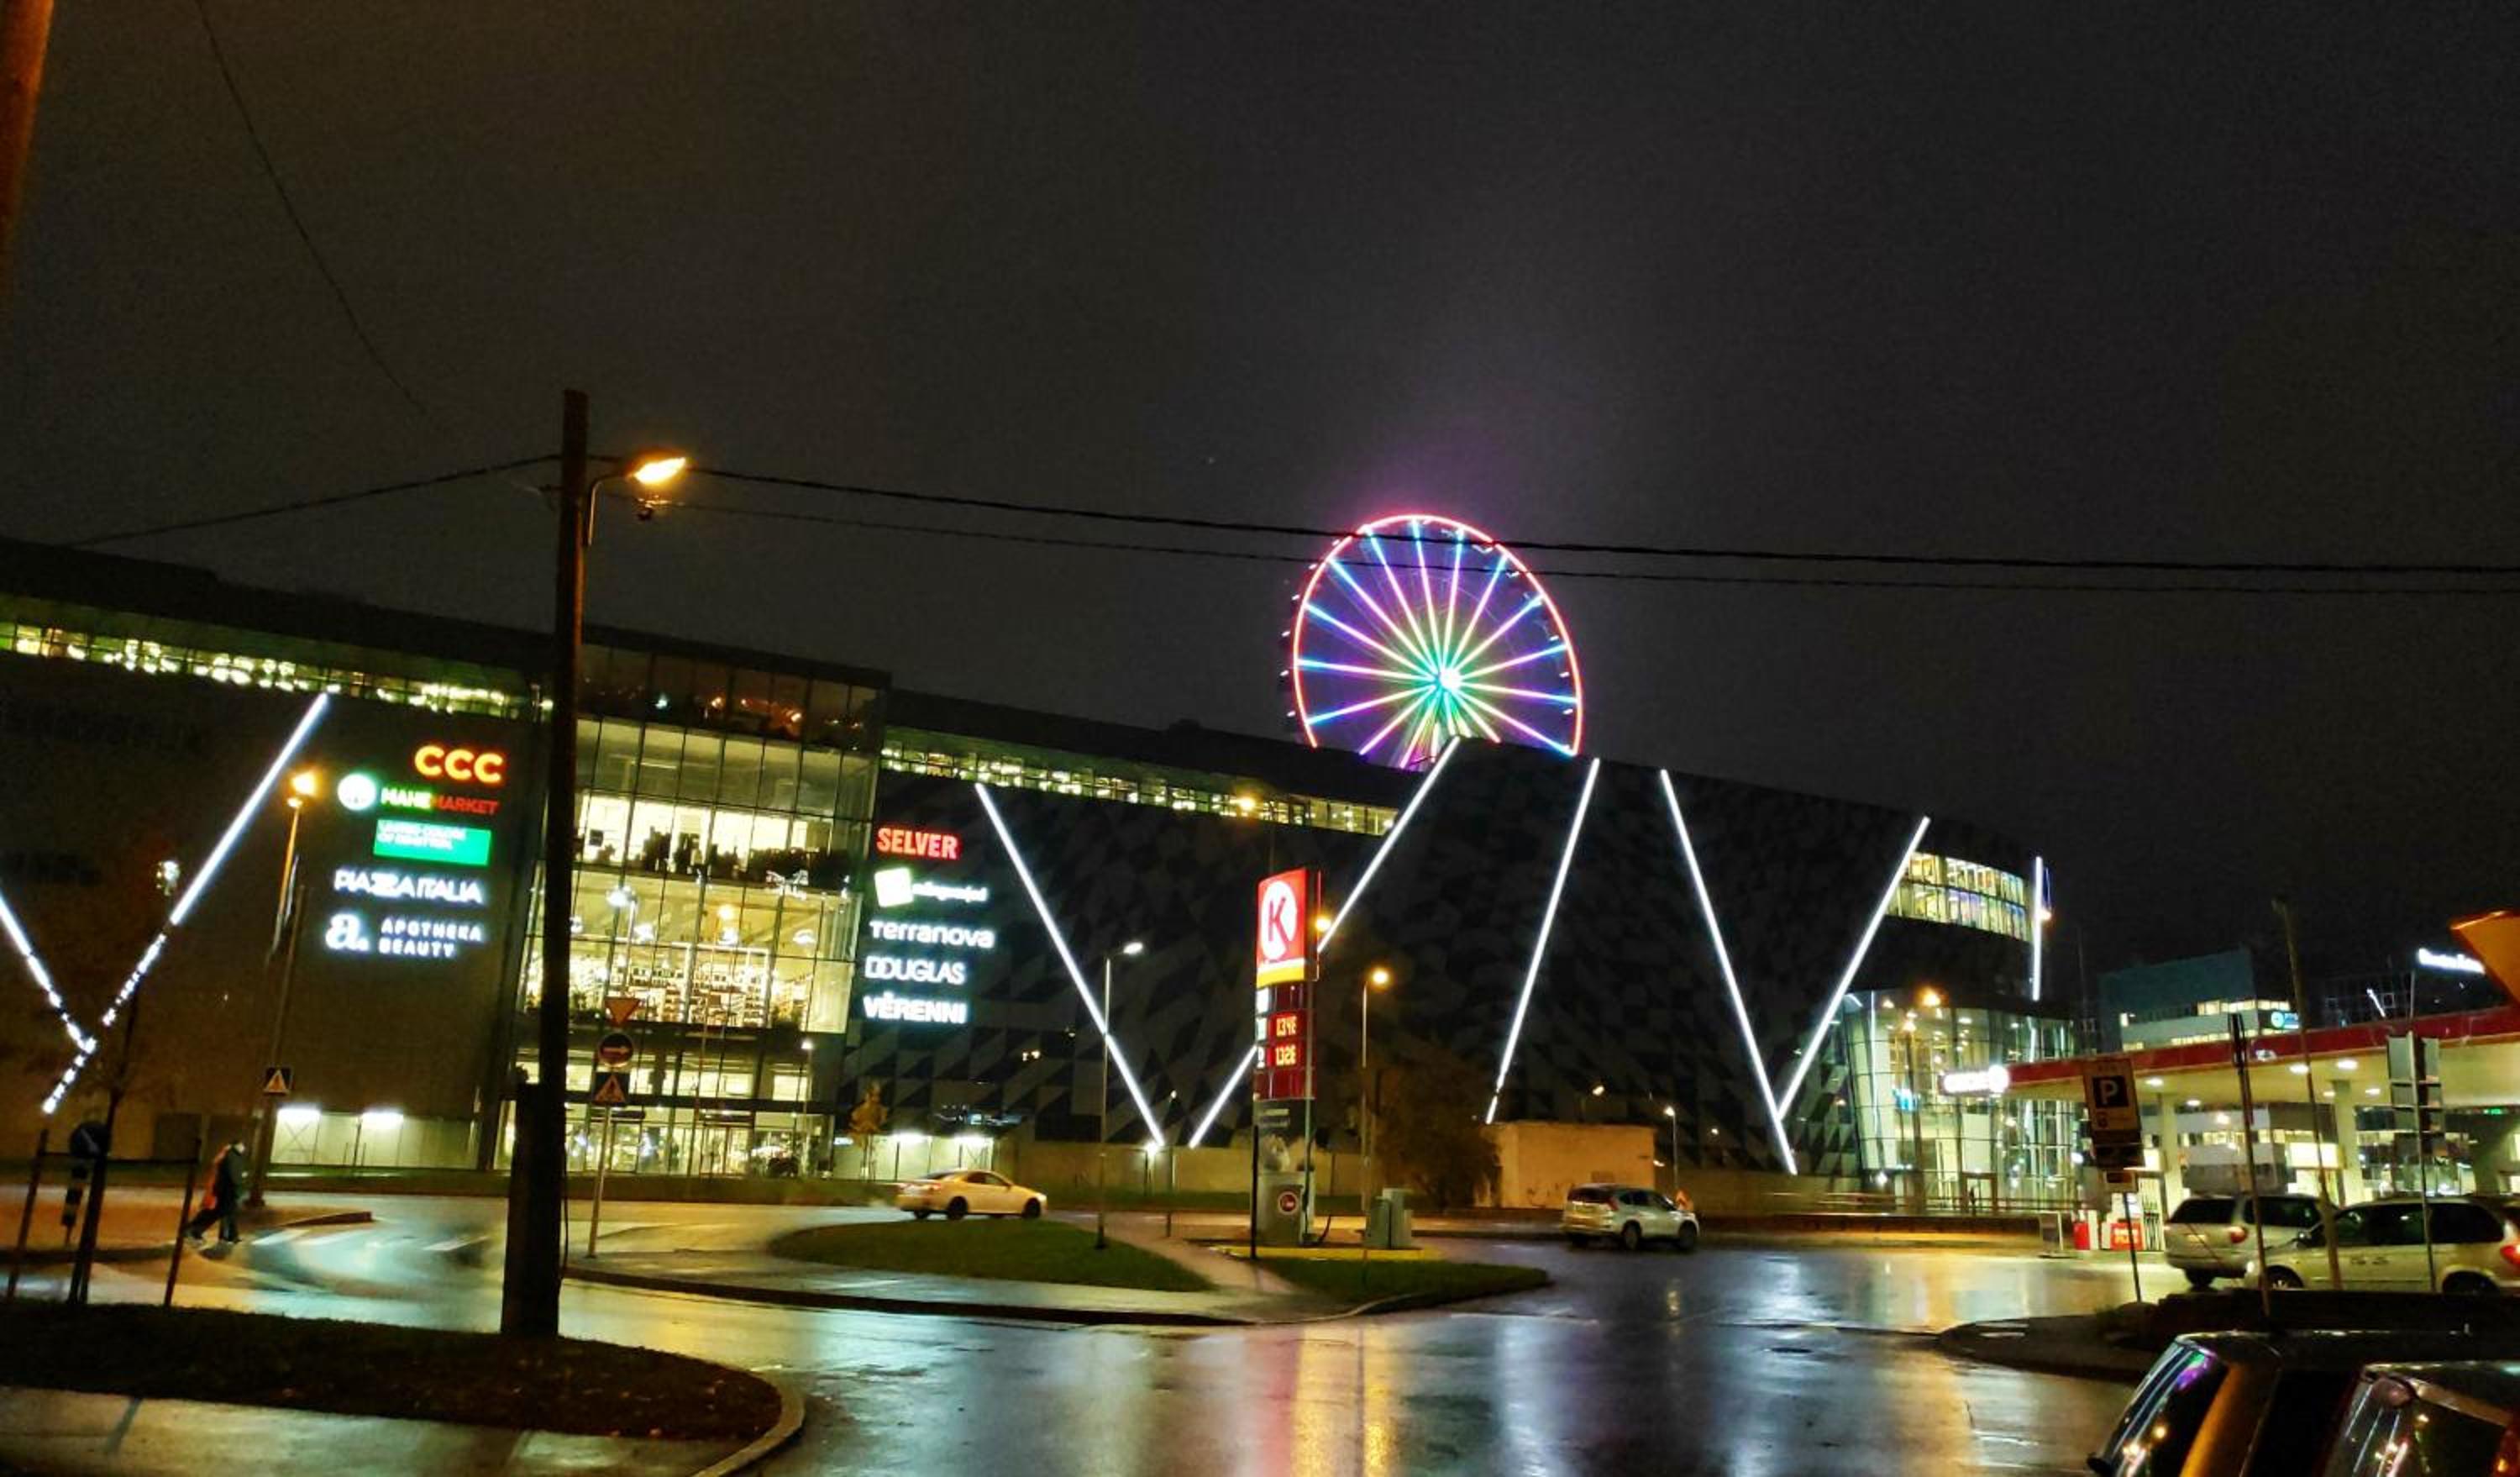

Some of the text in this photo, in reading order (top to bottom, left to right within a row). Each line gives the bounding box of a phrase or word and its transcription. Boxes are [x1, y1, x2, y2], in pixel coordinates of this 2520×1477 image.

[414, 744, 504, 783] CCC
[876, 827, 959, 859] SELVER
[417, 877, 484, 904] ITALIA
[381, 916, 484, 942] APOTHEKA
[378, 937, 455, 959] BEAUTY
[864, 955, 967, 986] DOUGLAS
